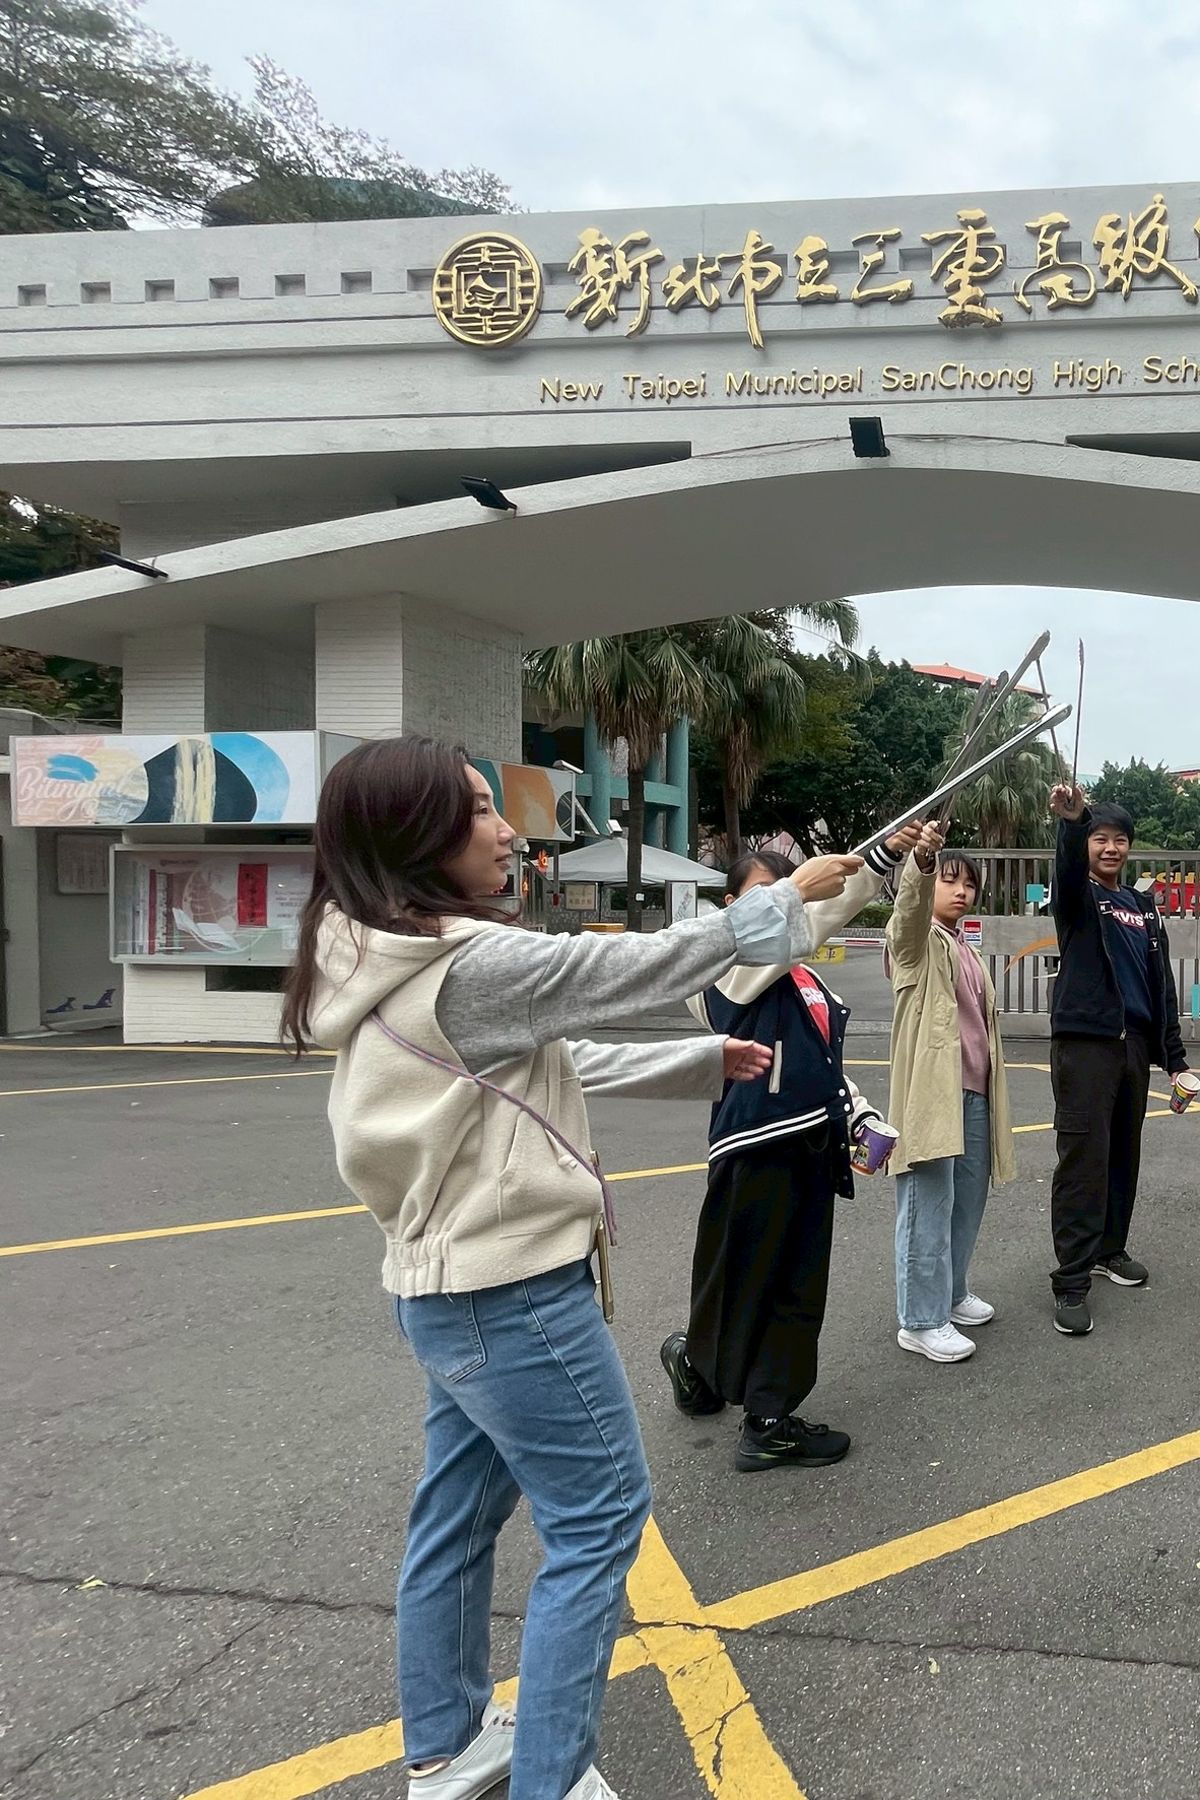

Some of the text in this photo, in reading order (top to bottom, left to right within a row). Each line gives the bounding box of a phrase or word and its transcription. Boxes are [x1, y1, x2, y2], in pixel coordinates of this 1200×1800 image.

[540, 377, 602, 401] New
[623, 371, 706, 401] Taipei
[725, 366, 863, 402] Municipal
[882, 361, 1033, 394] SanChong
[1053, 360, 1122, 392] High
